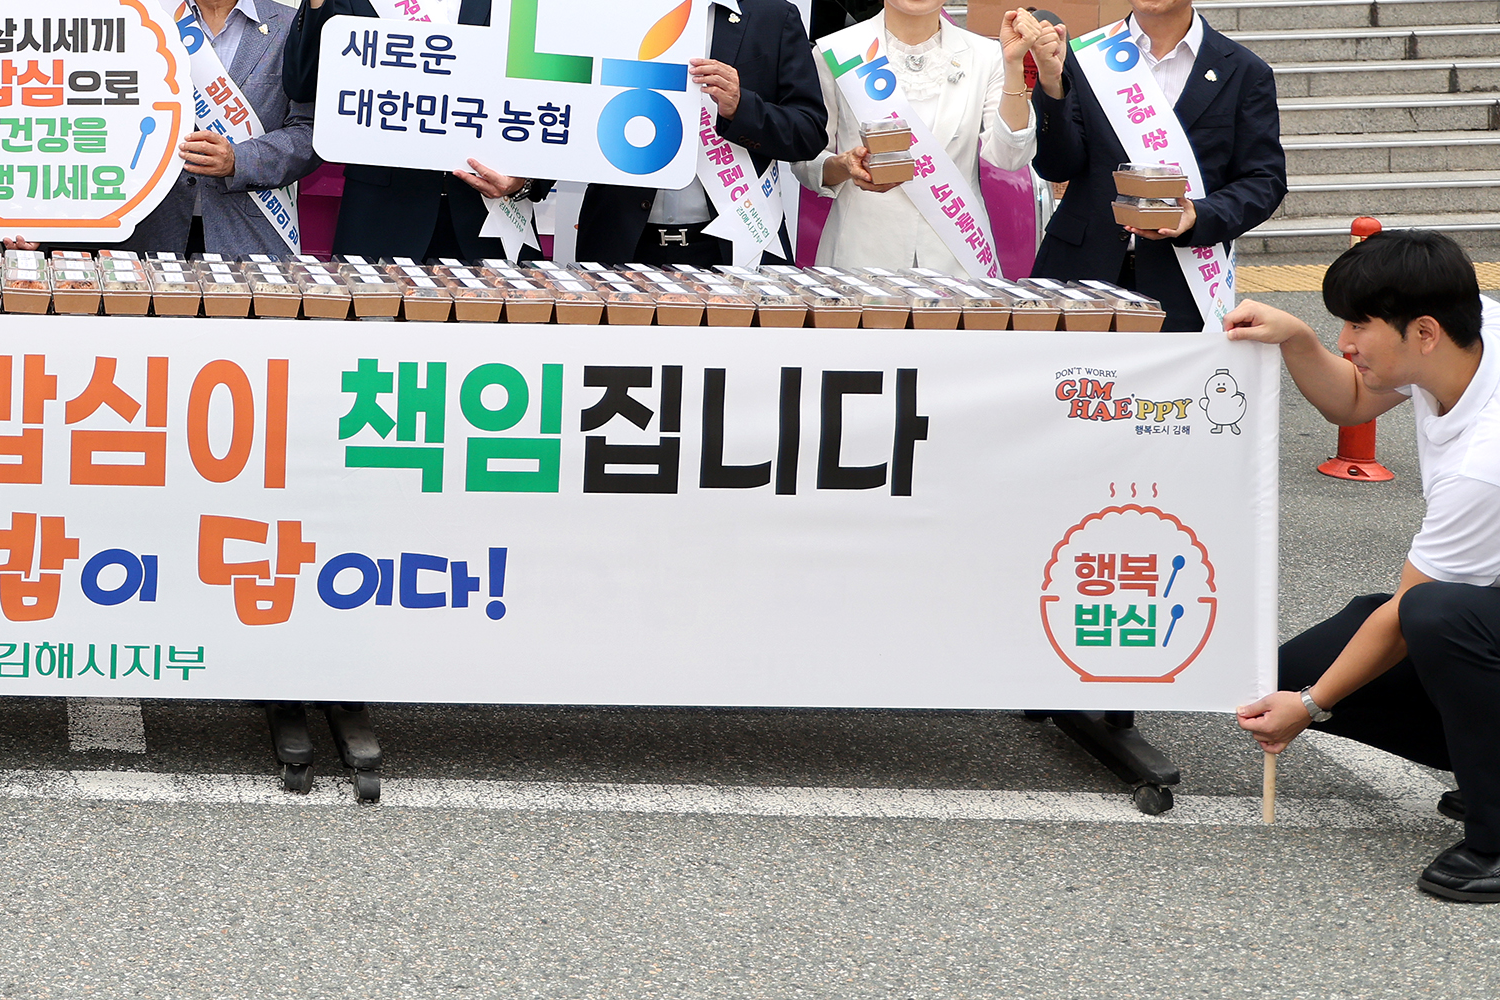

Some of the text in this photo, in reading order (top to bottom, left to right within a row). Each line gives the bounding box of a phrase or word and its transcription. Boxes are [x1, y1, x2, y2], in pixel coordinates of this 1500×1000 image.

[342, 30, 457, 76] 새로운
[337, 89, 571, 145] 대한민국 농협
[1116, 83, 1157, 124] 김해
[1054, 366, 1082, 380] DON'T
[1054, 378, 1115, 401] GIM
[339, 356, 929, 498] 책임집니다
[1135, 425, 1191, 436] 행복도시 김해
[198, 514, 507, 627] 답이다!
[1074, 552, 1160, 597] 행복
[1074, 603, 1157, 648] 밥심
